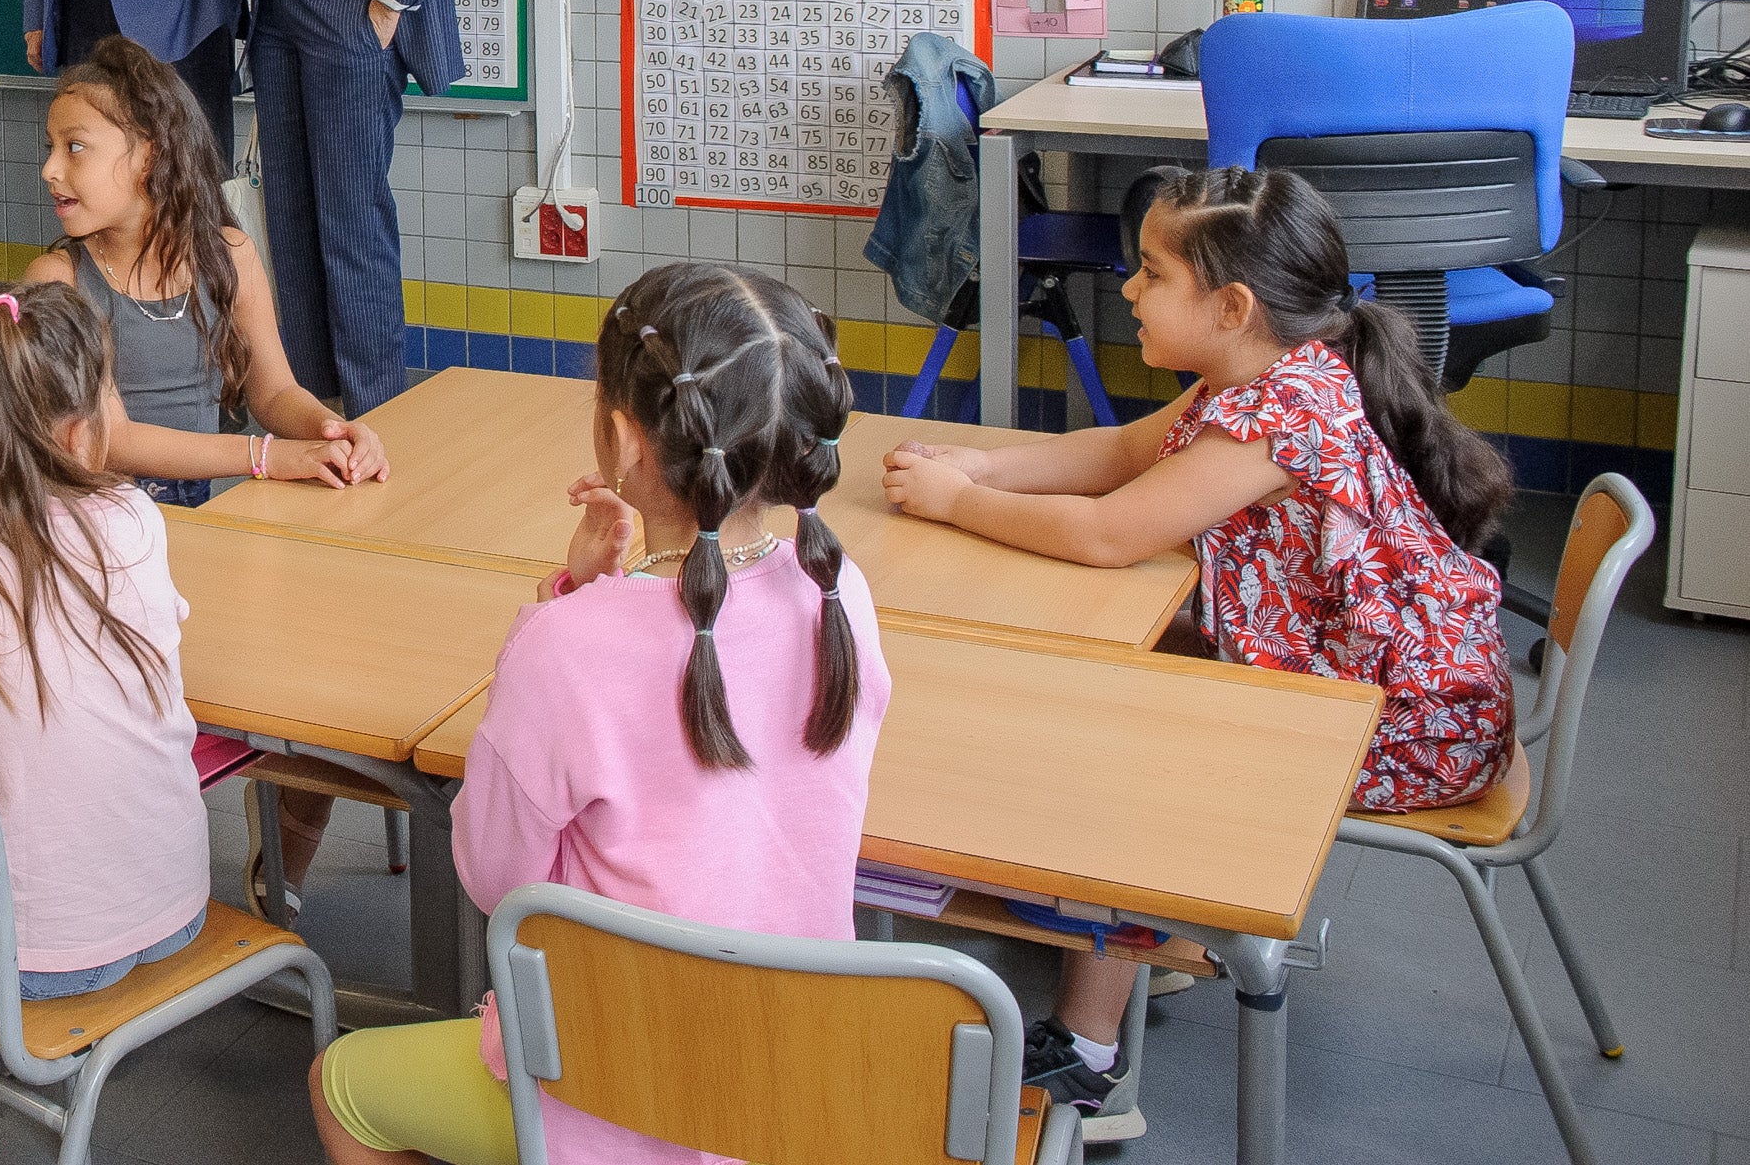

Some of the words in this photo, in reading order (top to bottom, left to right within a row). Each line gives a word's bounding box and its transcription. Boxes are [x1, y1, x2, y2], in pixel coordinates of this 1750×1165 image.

[482, 17, 499, 31] 79
[646, 3, 667, 19] 20
[679, 2, 697, 20] 21
[706, 5, 726, 23] 22
[739, 5, 759, 19] 23
[771, 6, 791, 21] 24
[803, 8, 823, 22] 25
[833, 8, 854, 22] 26
[867, 6, 891, 23] 27
[901, 10, 923, 25] 28
[939, 10, 960, 24] 29
[647, 27, 667, 41] 30
[678, 25, 698, 40] 31
[708, 29, 727, 43] 32
[739, 30, 758, 43] 33
[770, 31, 790, 46] 34
[800, 30, 820, 46] 35
[835, 31, 855, 47] 36
[867, 34, 890, 49] 37
[482, 42, 500, 56] 89
[482, 65, 500, 79] 99
[647, 51, 667, 65] 40
[676, 55, 695, 71] 41
[707, 52, 727, 67] 42
[737, 57, 757, 71] 43
[770, 54, 789, 68] 44
[801, 56, 823, 71] 45
[831, 56, 851, 71] 46
[646, 74, 666, 89] 50
[680, 80, 699, 94] 51
[711, 79, 730, 93] 52
[739, 80, 760, 97] 53
[769, 78, 789, 94] 54
[801, 82, 821, 97] 55
[835, 87, 855, 101] 56
[647, 99, 668, 114] 60
[680, 102, 699, 117] 61
[709, 104, 729, 118] 62
[742, 103, 762, 118] 64
[768, 102, 789, 119] 63
[800, 106, 821, 121] 65
[835, 110, 856, 123] 66
[646, 122, 666, 136] 70
[677, 125, 696, 140] 71
[710, 126, 728, 141] 72
[741, 130, 759, 146] 73
[769, 126, 790, 140] 74
[801, 129, 822, 145] 75
[836, 132, 857, 146] 76
[866, 137, 887, 152] 77
[650, 146, 670, 160] 80
[678, 147, 697, 161] 81
[708, 152, 727, 166] 82
[739, 152, 759, 167] 83
[768, 154, 788, 169] 84
[808, 155, 827, 169] 85
[835, 158, 856, 174] 86
[645, 167, 665, 182] 90
[679, 172, 698, 186] 91
[710, 175, 730, 188] 92
[740, 178, 761, 191] 93
[767, 176, 789, 189] 94
[802, 182, 823, 198] 95
[837, 180, 859, 199] 96
[637, 187, 670, 205] 100
